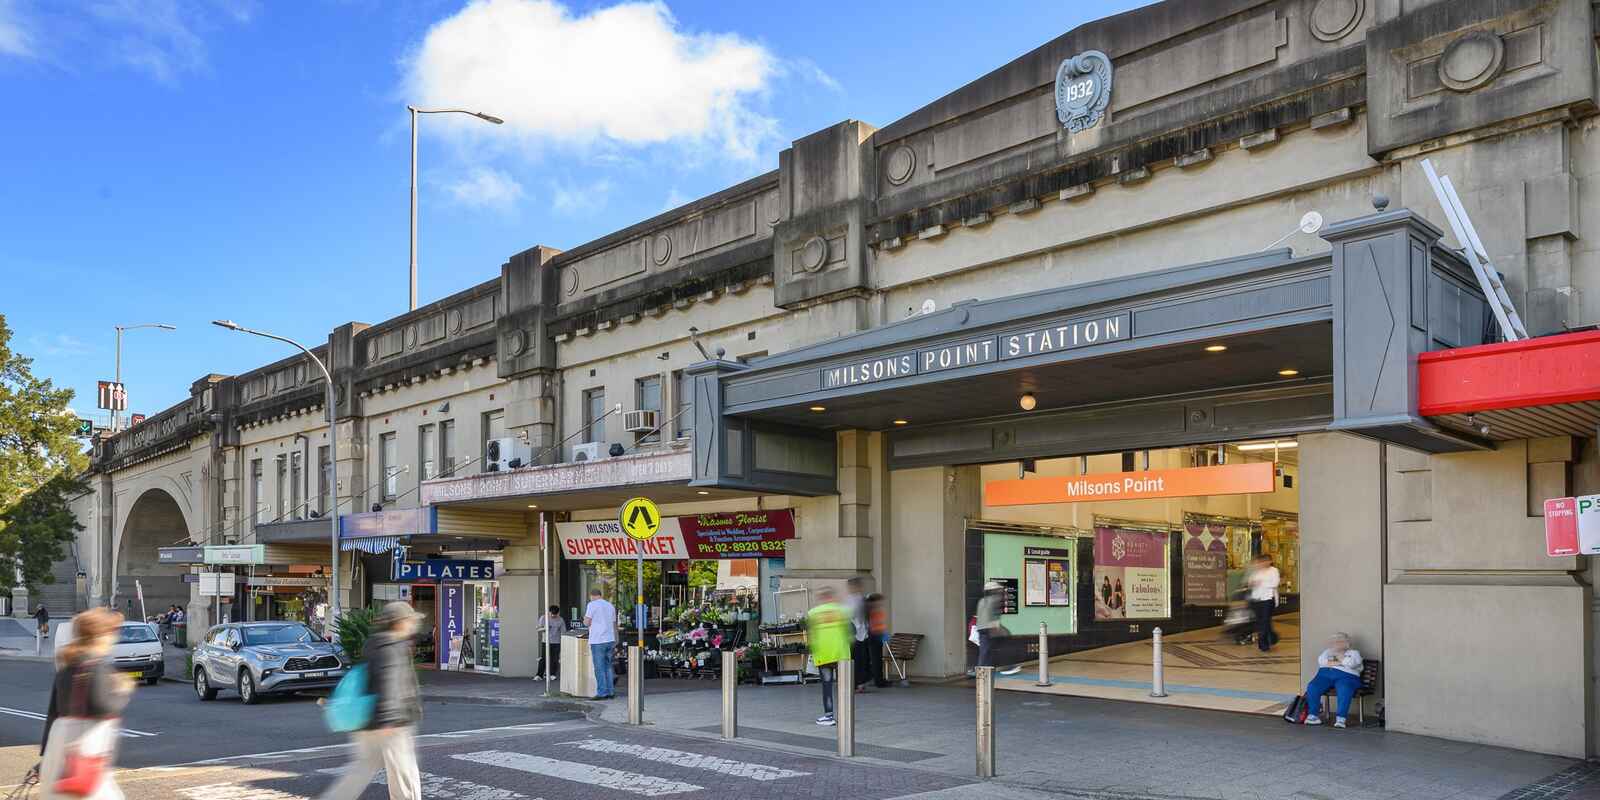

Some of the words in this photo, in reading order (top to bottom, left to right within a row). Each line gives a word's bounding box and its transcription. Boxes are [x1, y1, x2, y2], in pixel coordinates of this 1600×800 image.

[1067, 80, 1093, 102] 1932
[827, 356, 910, 387] MILSONS
[925, 340, 992, 371] POINT
[1009, 317, 1119, 356] STATION
[1067, 480, 1120, 496] Milsons
[1124, 477, 1164, 493] Point
[586, 523, 619, 534] MILSONS
[698, 543, 714, 553] Ph:
[401, 564, 492, 578] PILATES
